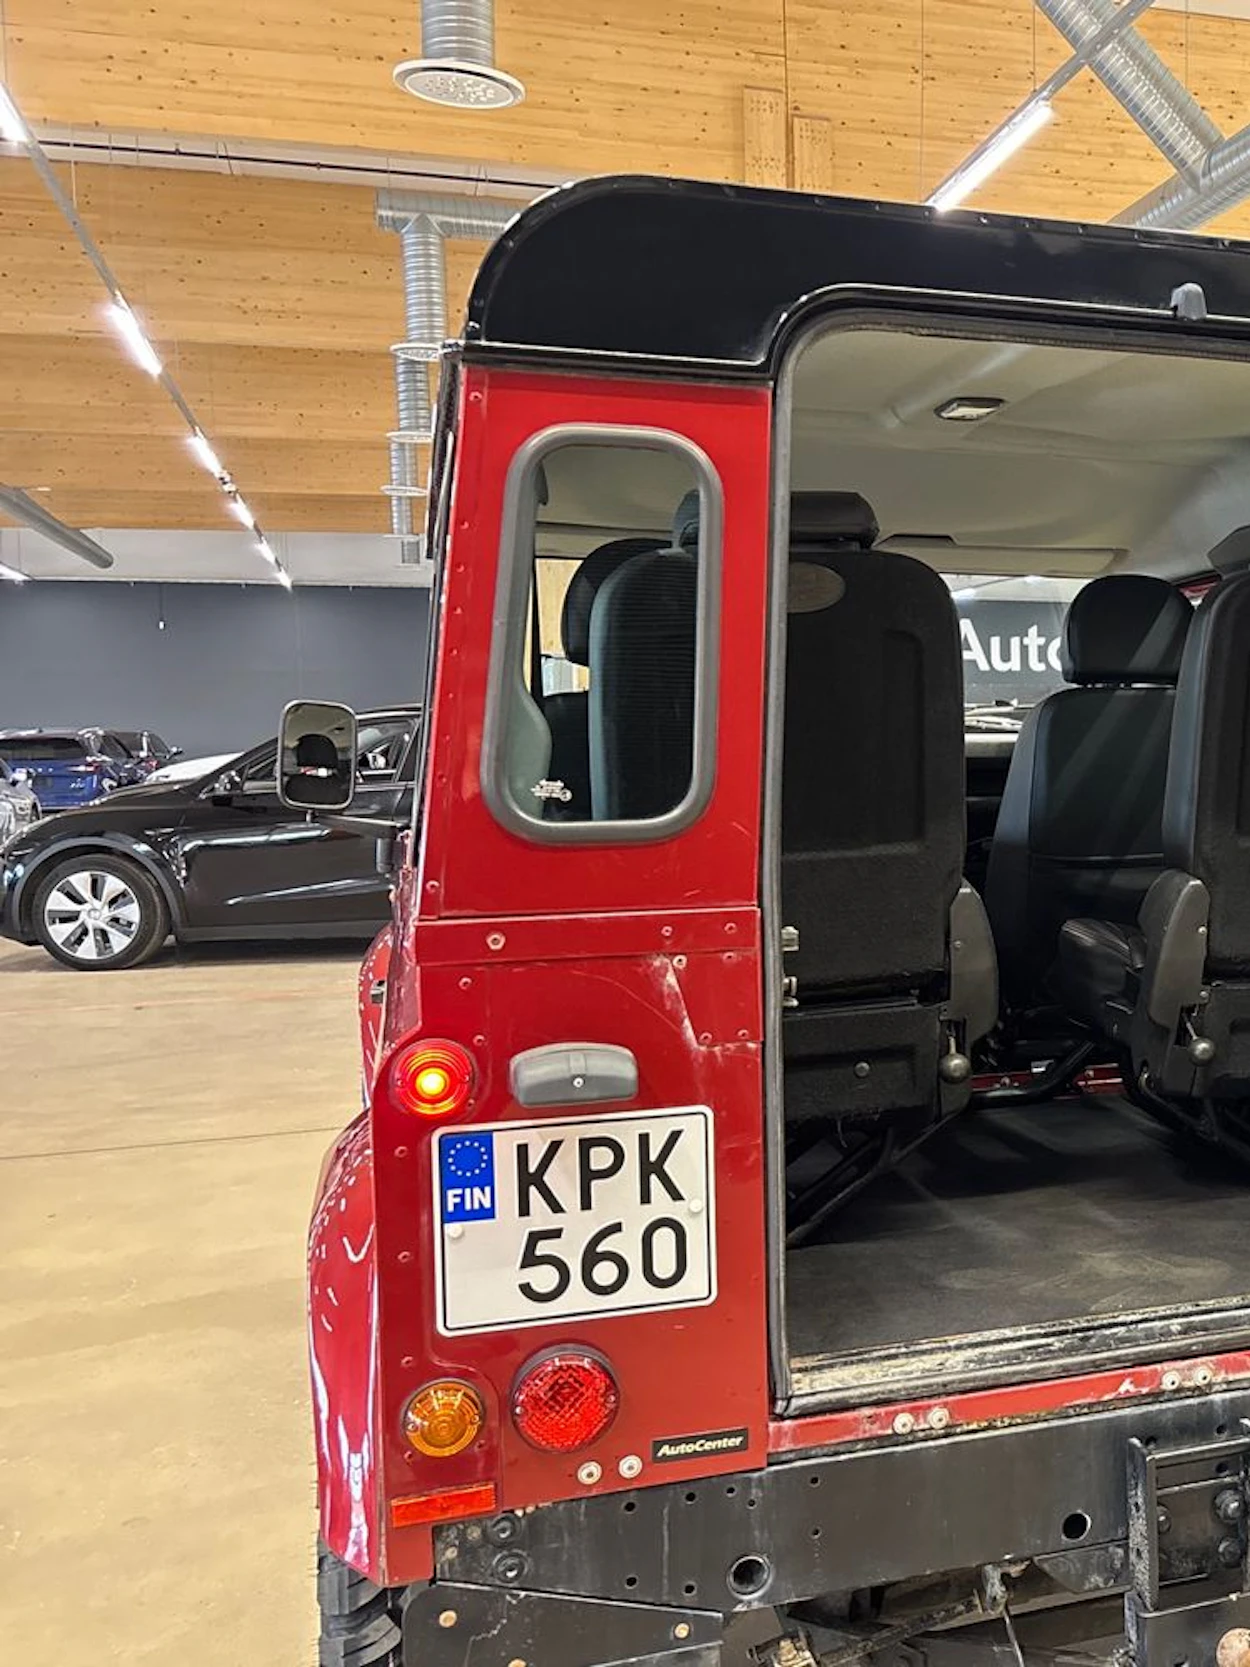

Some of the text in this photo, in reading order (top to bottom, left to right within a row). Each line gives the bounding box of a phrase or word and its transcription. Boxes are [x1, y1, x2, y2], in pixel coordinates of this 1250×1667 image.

[447, 1186, 491, 1212] FIN
[516, 1129, 686, 1217] KPK
[518, 1217, 687, 1303] 560
[656, 1436, 744, 1457] AutoCenter
